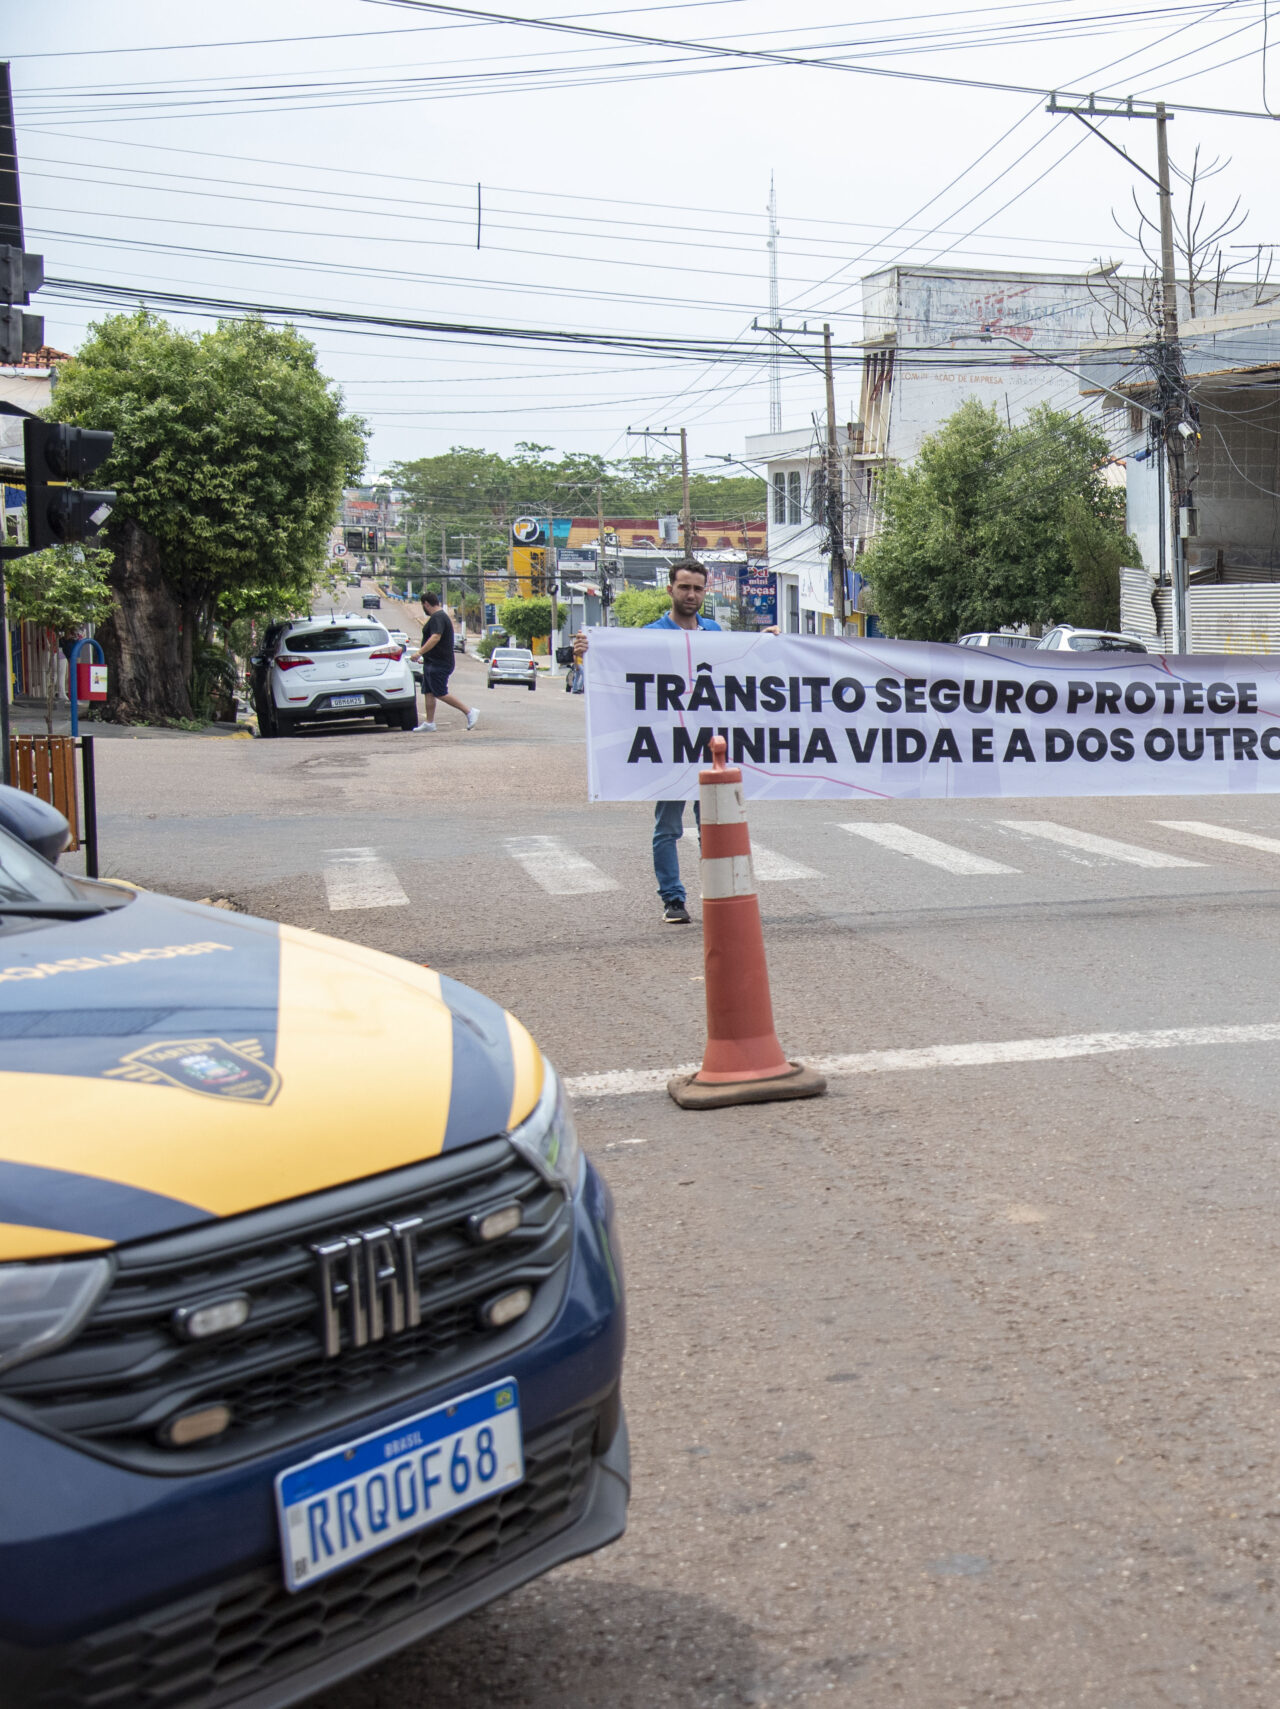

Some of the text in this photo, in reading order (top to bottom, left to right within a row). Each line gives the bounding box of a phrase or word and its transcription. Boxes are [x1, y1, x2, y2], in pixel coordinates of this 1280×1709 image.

[626, 662, 1259, 714] TRÂNSITO SEGURO PROTEGE
[627, 726, 663, 763] A
[846, 728, 962, 763] VIDA
[972, 728, 994, 762] E
[1002, 728, 1036, 763] A
[1045, 728, 1135, 763] DOS
[310, 1217, 424, 1358] FIAT
[384, 1431, 424, 1459] BRASIL
